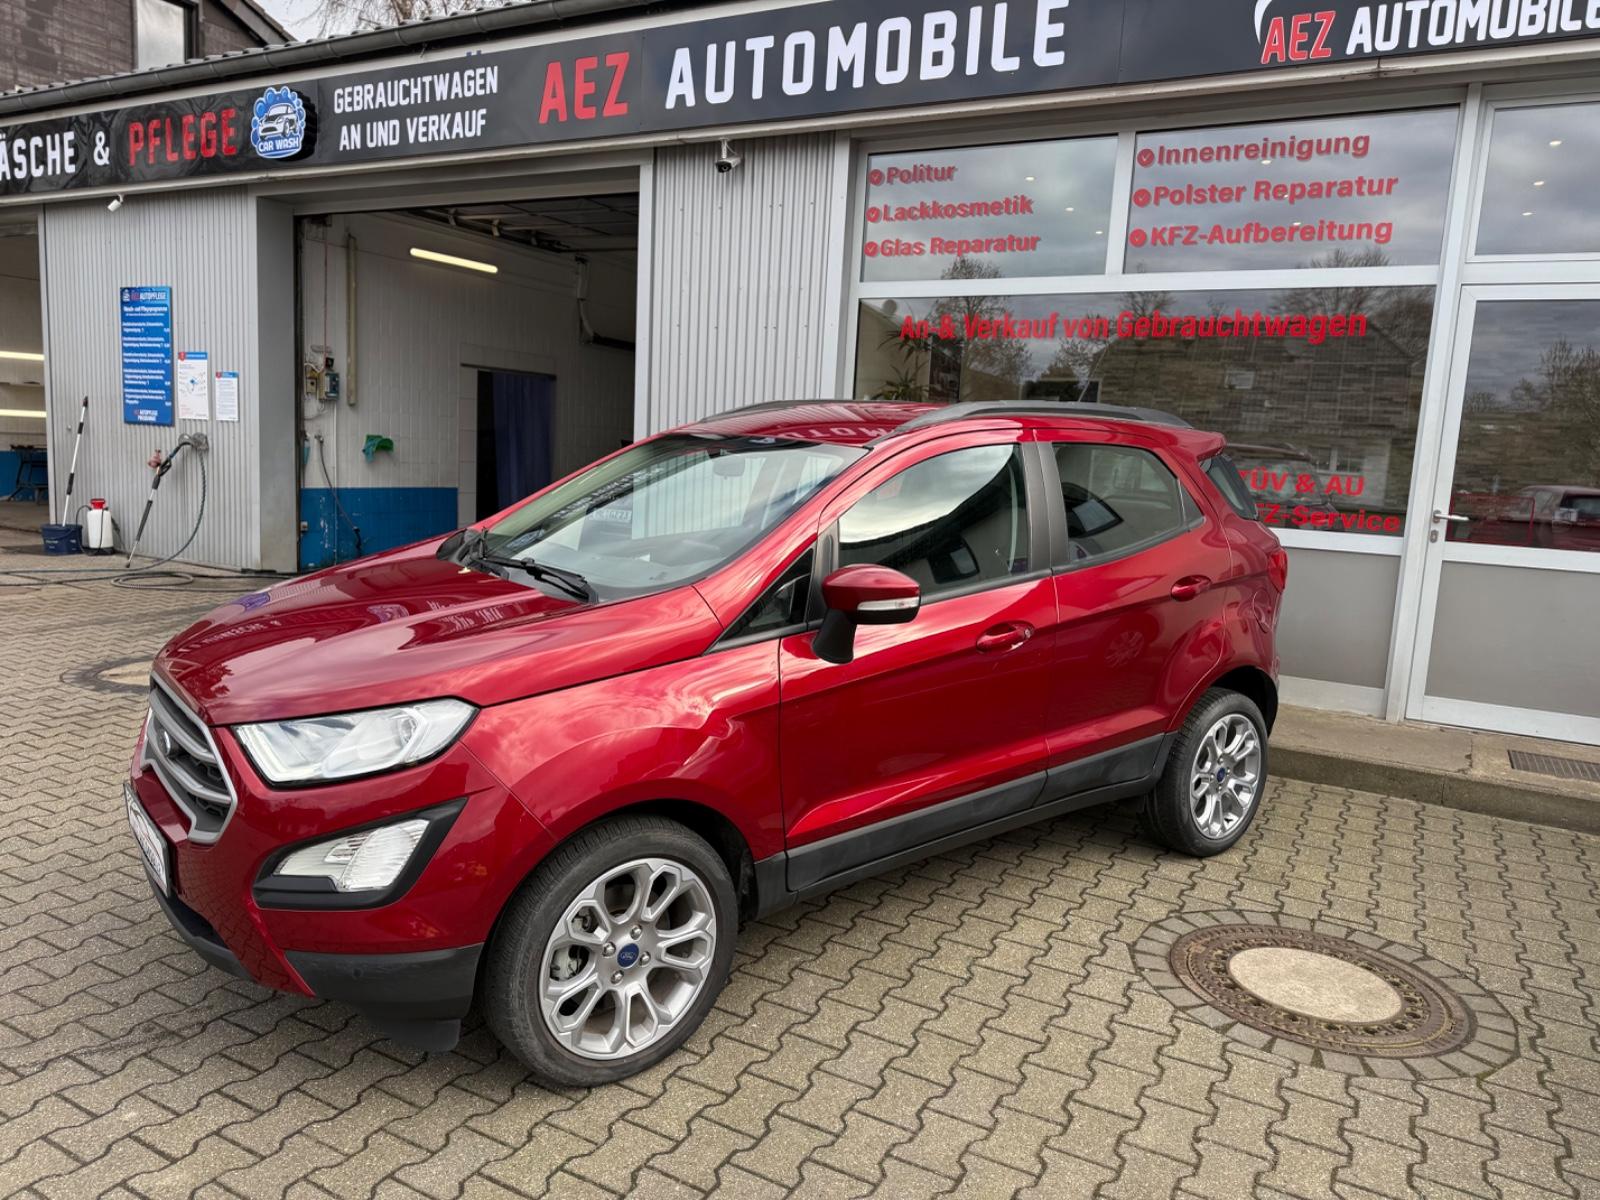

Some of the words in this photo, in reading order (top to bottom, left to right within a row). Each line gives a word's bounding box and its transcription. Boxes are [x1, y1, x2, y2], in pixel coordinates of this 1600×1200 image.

[1260, 10, 1337, 65] AEZ
[538, 51, 630, 125] AEZ
[665, 0, 1070, 110] AUTOMOBILE
[334, 65, 498, 114] GEBRAUCHTWAGEN
[93, 131, 110, 166] &
[128, 108, 237, 167] PFLEGE
[259, 140, 274, 152] CAR
[275, 137, 299, 150] WASH
[339, 124, 361, 151] AN
[366, 119, 400, 148] UND
[406, 108, 487, 144] VERKAUF
[1157, 134, 1371, 165] Innenreinigung
[886, 163, 958, 185] Politur
[1153, 183, 1247, 206] Polster
[1253, 175, 1399, 204] Reparatur
[882, 194, 1035, 222] Lackkosmetik
[880, 238, 926, 257] Glas
[930, 234, 1041, 257] Reparatur
[1150, 219, 1394, 245] KFZ-Aufbereitung
[963, 311, 1059, 340] Verkauf
[1063, 315, 1109, 339] von
[1116, 308, 1368, 345] Gebrauchtwagen
[1295, 473, 1316, 495] &
[1323, 474, 1365, 497] AU
